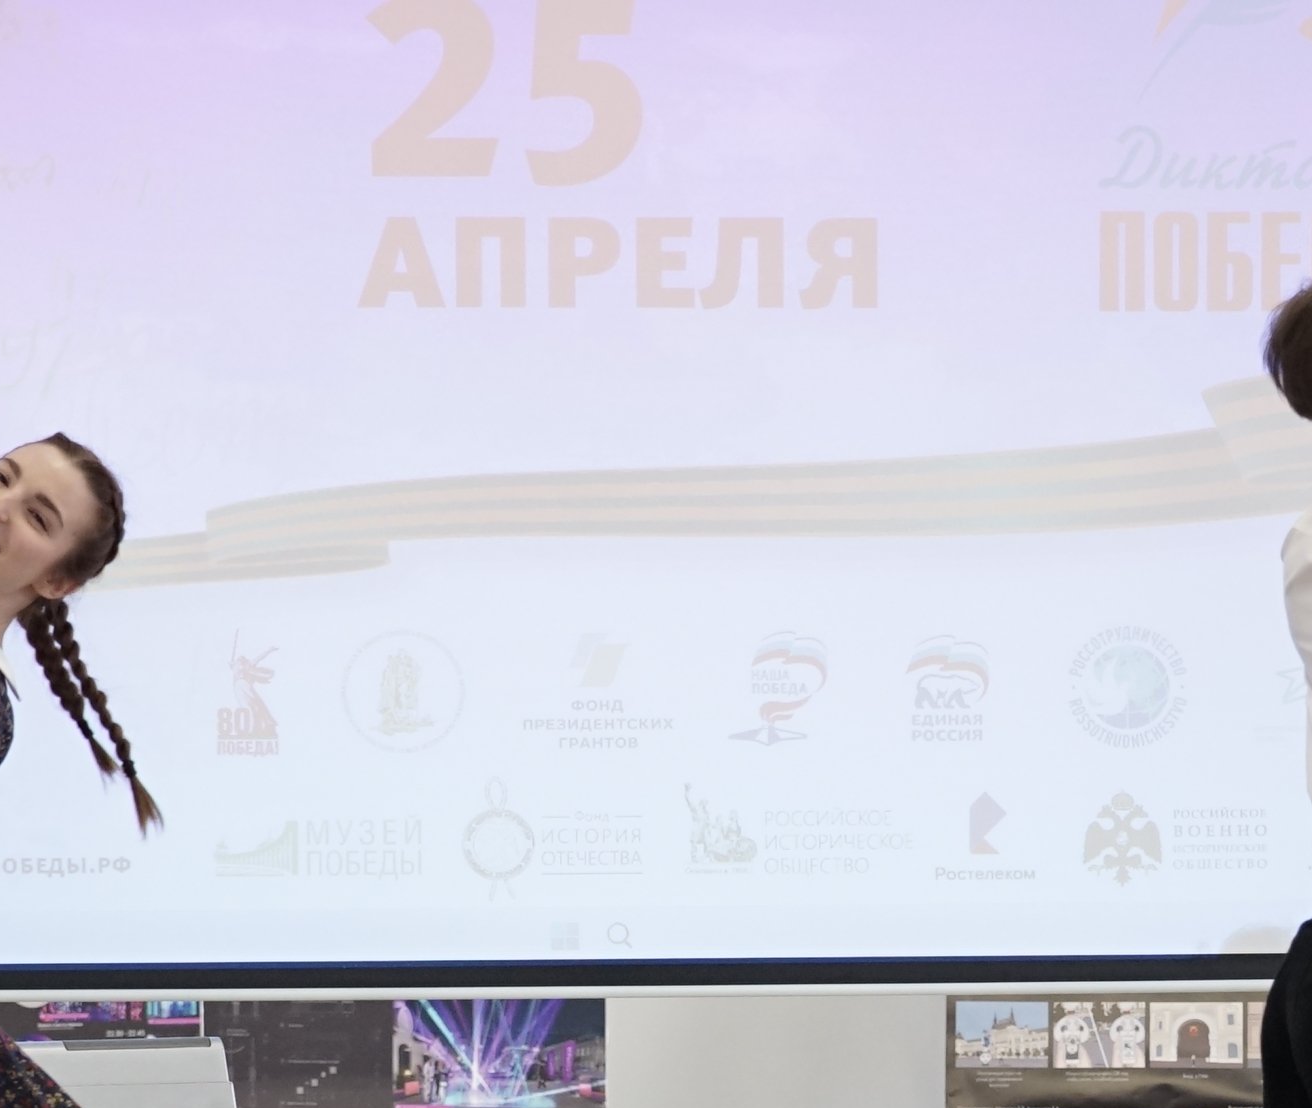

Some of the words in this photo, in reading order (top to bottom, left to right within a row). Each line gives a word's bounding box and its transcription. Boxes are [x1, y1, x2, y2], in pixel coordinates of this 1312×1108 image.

[365, 0, 644, 187] 25
[357, 216, 879, 310] АПРЕЛЯ
[1068, 625, 1188, 678] РОССОТРУДНИЧЕСТВО
[751, 669, 790, 681] НАША
[751, 682, 808, 696] ПОБЕДА
[571, 699, 624, 714] ФОНД
[217, 707, 253, 736] 80
[522, 717, 674, 732] ПРЕЗИДЕНТСКИХ
[911, 714, 983, 728] ЕДИНАЯ
[1068, 696, 1188, 750] ROSSOTRUDNICHESTVO
[559, 736, 639, 750] ГРАНТОВ
[911, 729, 983, 742] РОССИЯ
[217, 739, 279, 757] ПОБЕДА!
[763, 807, 894, 827] РОССИЙСКОЕ
[1172, 806, 1268, 820] РОССИЙСКОЕ
[306, 814, 422, 845] МУЗЕЙ
[541, 827, 641, 844] ИСТОРИЯ
[1173, 824, 1269, 838] ВОЕННО
[763, 833, 915, 852] ИСТОРИЧЕСКОЕ
[306, 849, 422, 880] ПОБЕДЫ
[541, 850, 642, 866] ОТЕЧЕСТВА
[1172, 857, 1269, 871] ОБЩЕСТВО
[763, 857, 871, 877] ОБЩЕСТВО
[934, 866, 1036, 881] Ростелеком
